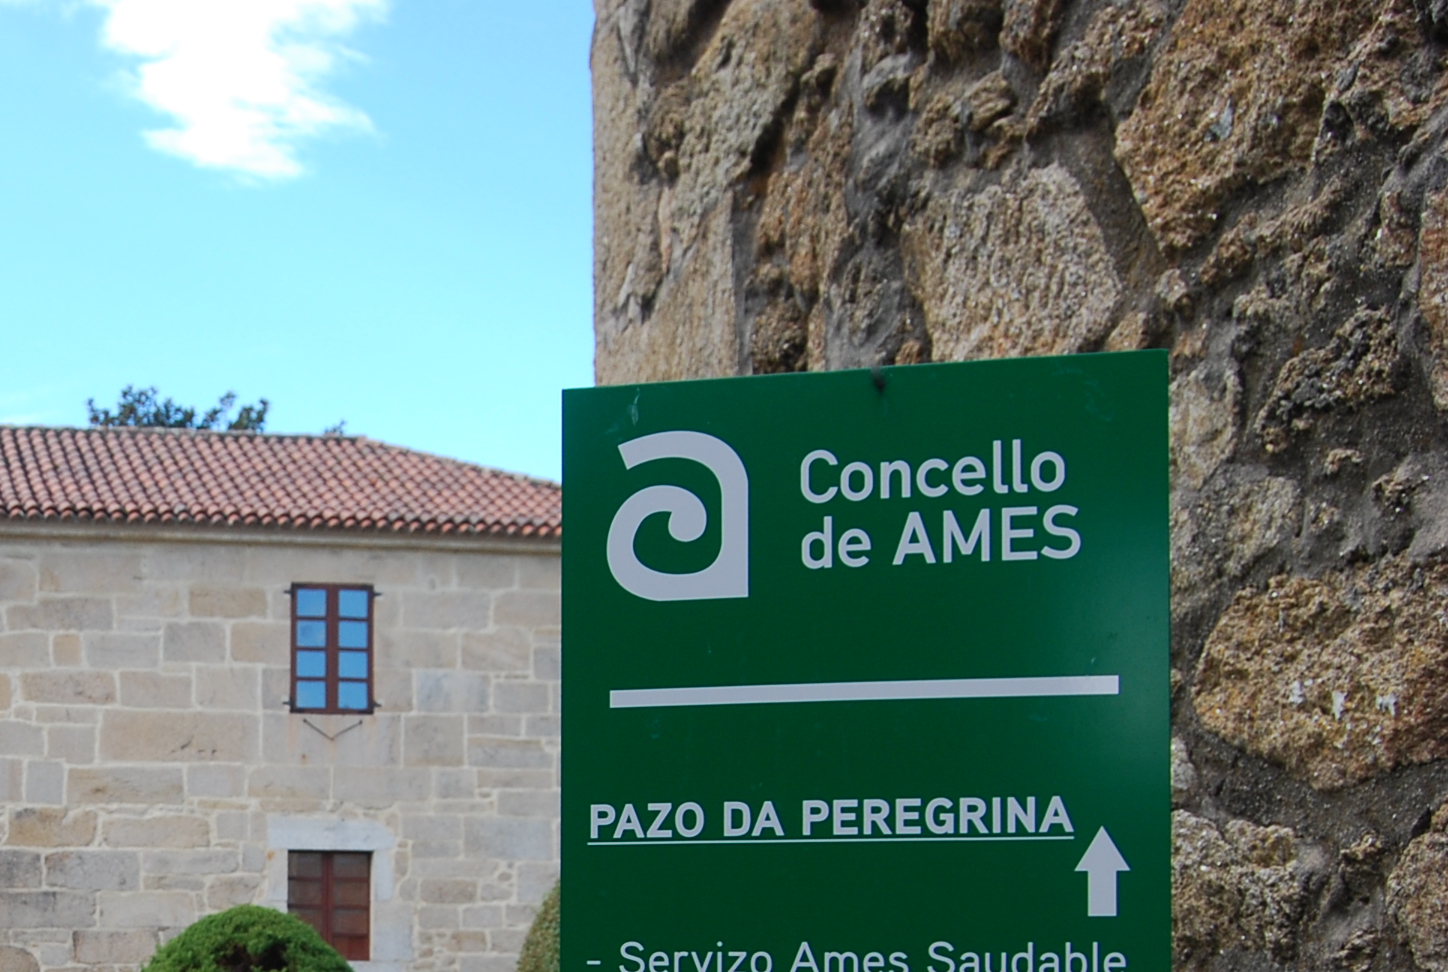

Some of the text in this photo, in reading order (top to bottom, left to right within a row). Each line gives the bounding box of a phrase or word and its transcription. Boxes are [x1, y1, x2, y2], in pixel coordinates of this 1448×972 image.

[800, 439, 1065, 504] Concello
[801, 504, 1081, 569] de AMES
[590, 795, 1074, 839] PAZO DA PEREGRINA
